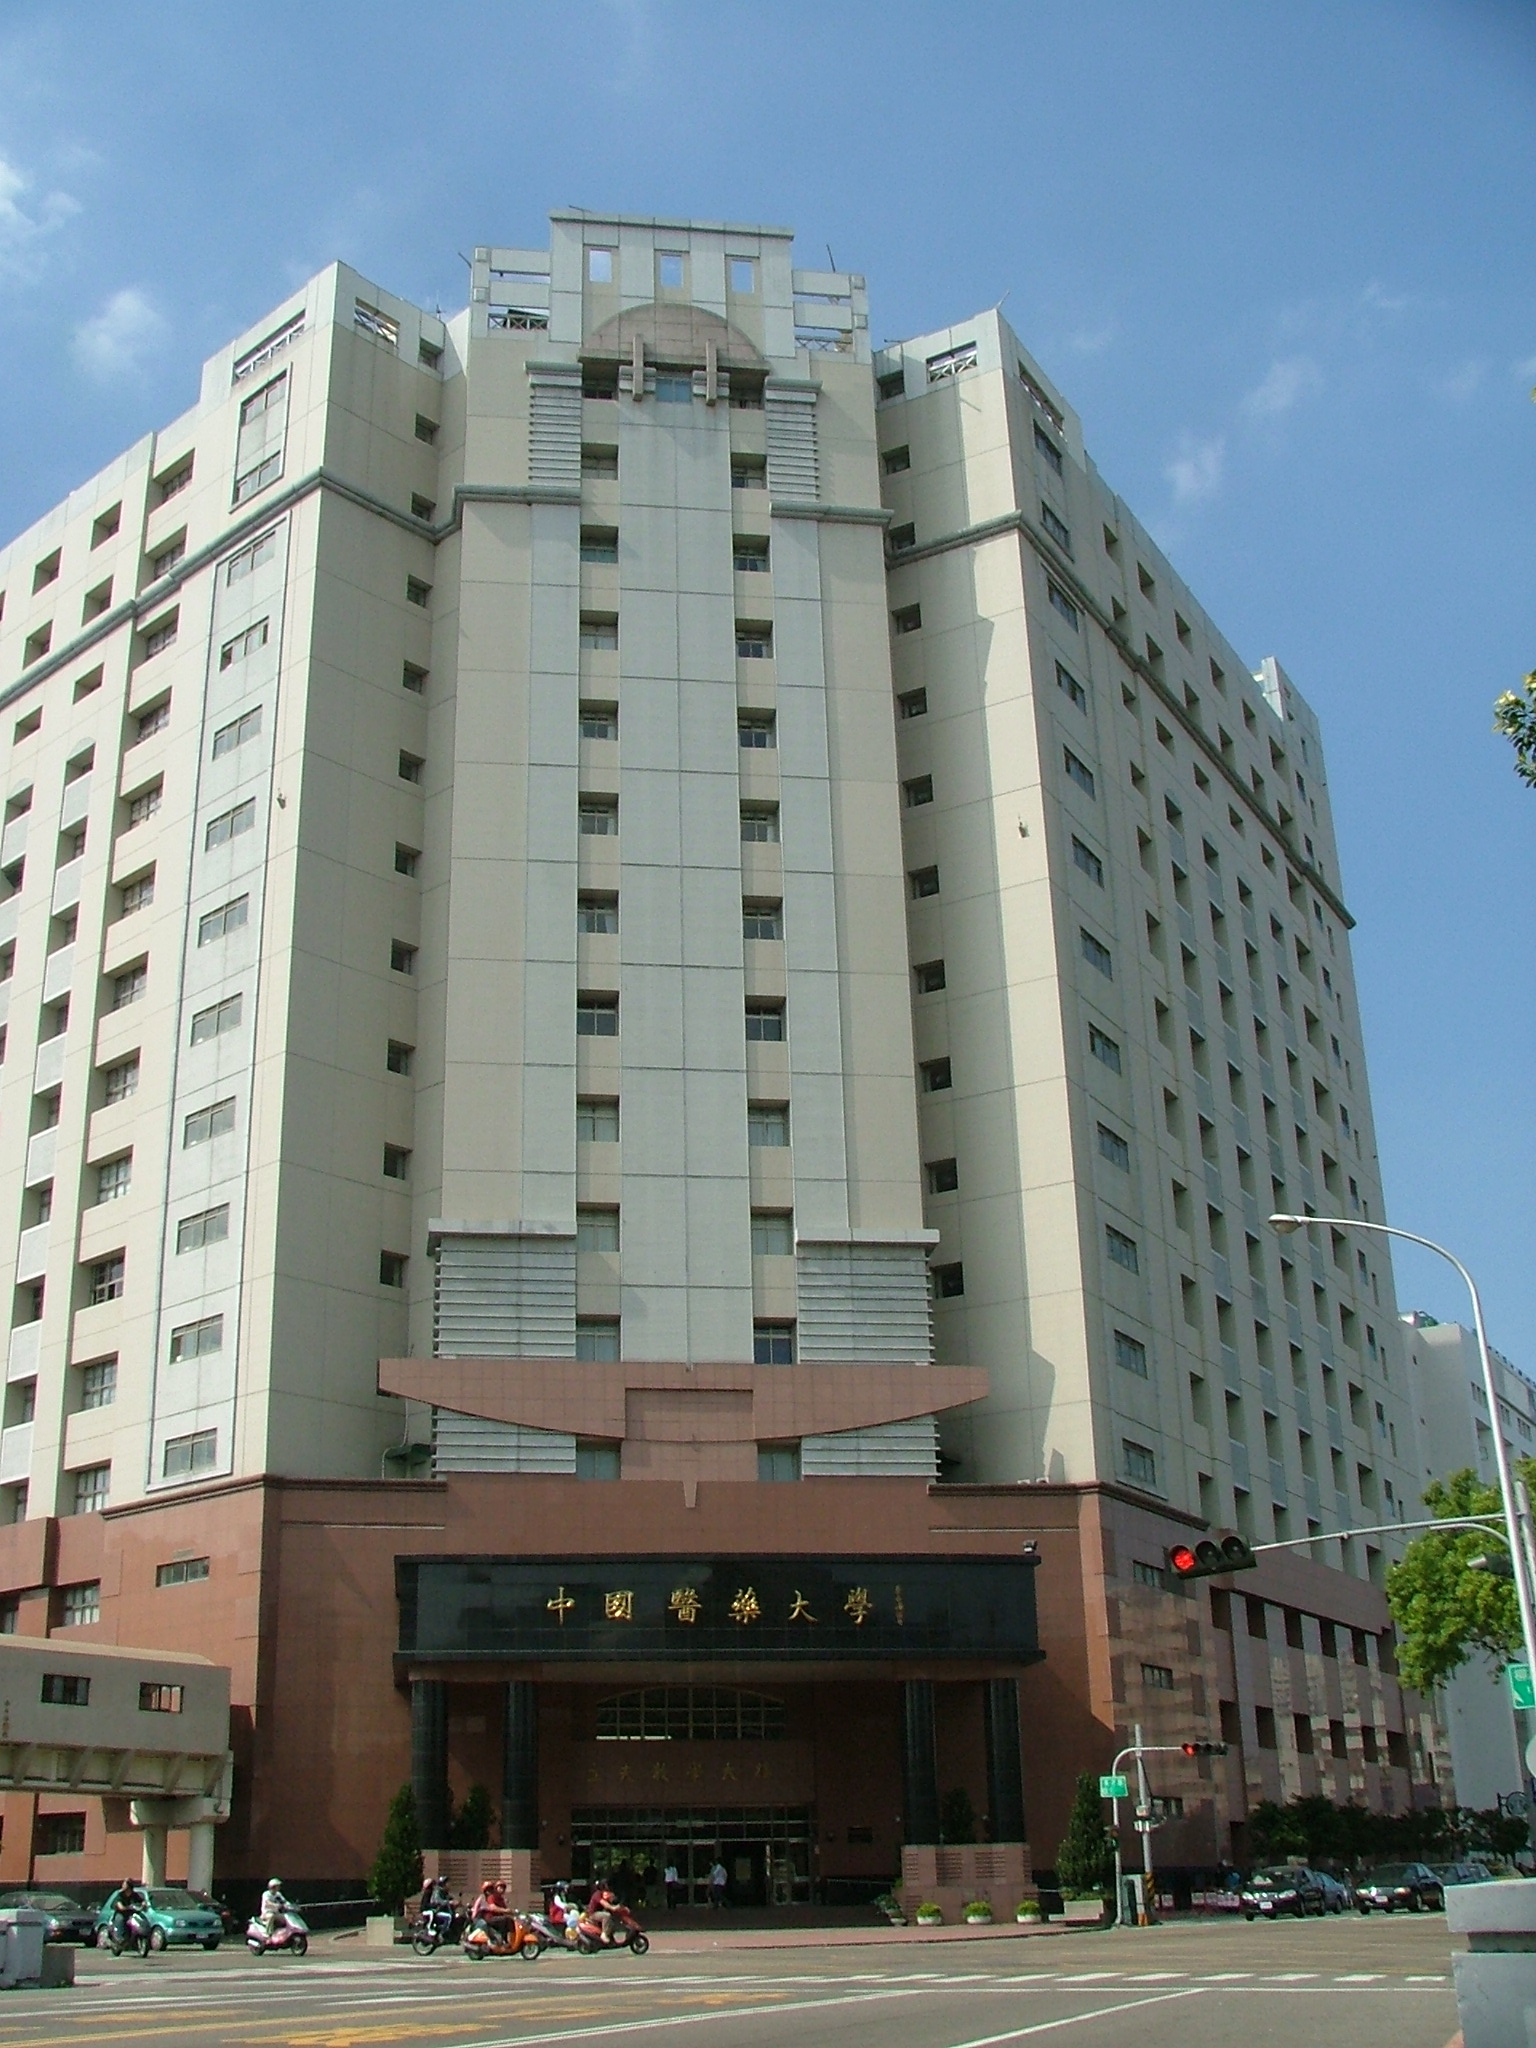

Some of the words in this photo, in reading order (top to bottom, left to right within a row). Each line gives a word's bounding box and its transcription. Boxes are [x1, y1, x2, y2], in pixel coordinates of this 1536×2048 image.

[547, 1586, 873, 1625] 中國醫藥大學
